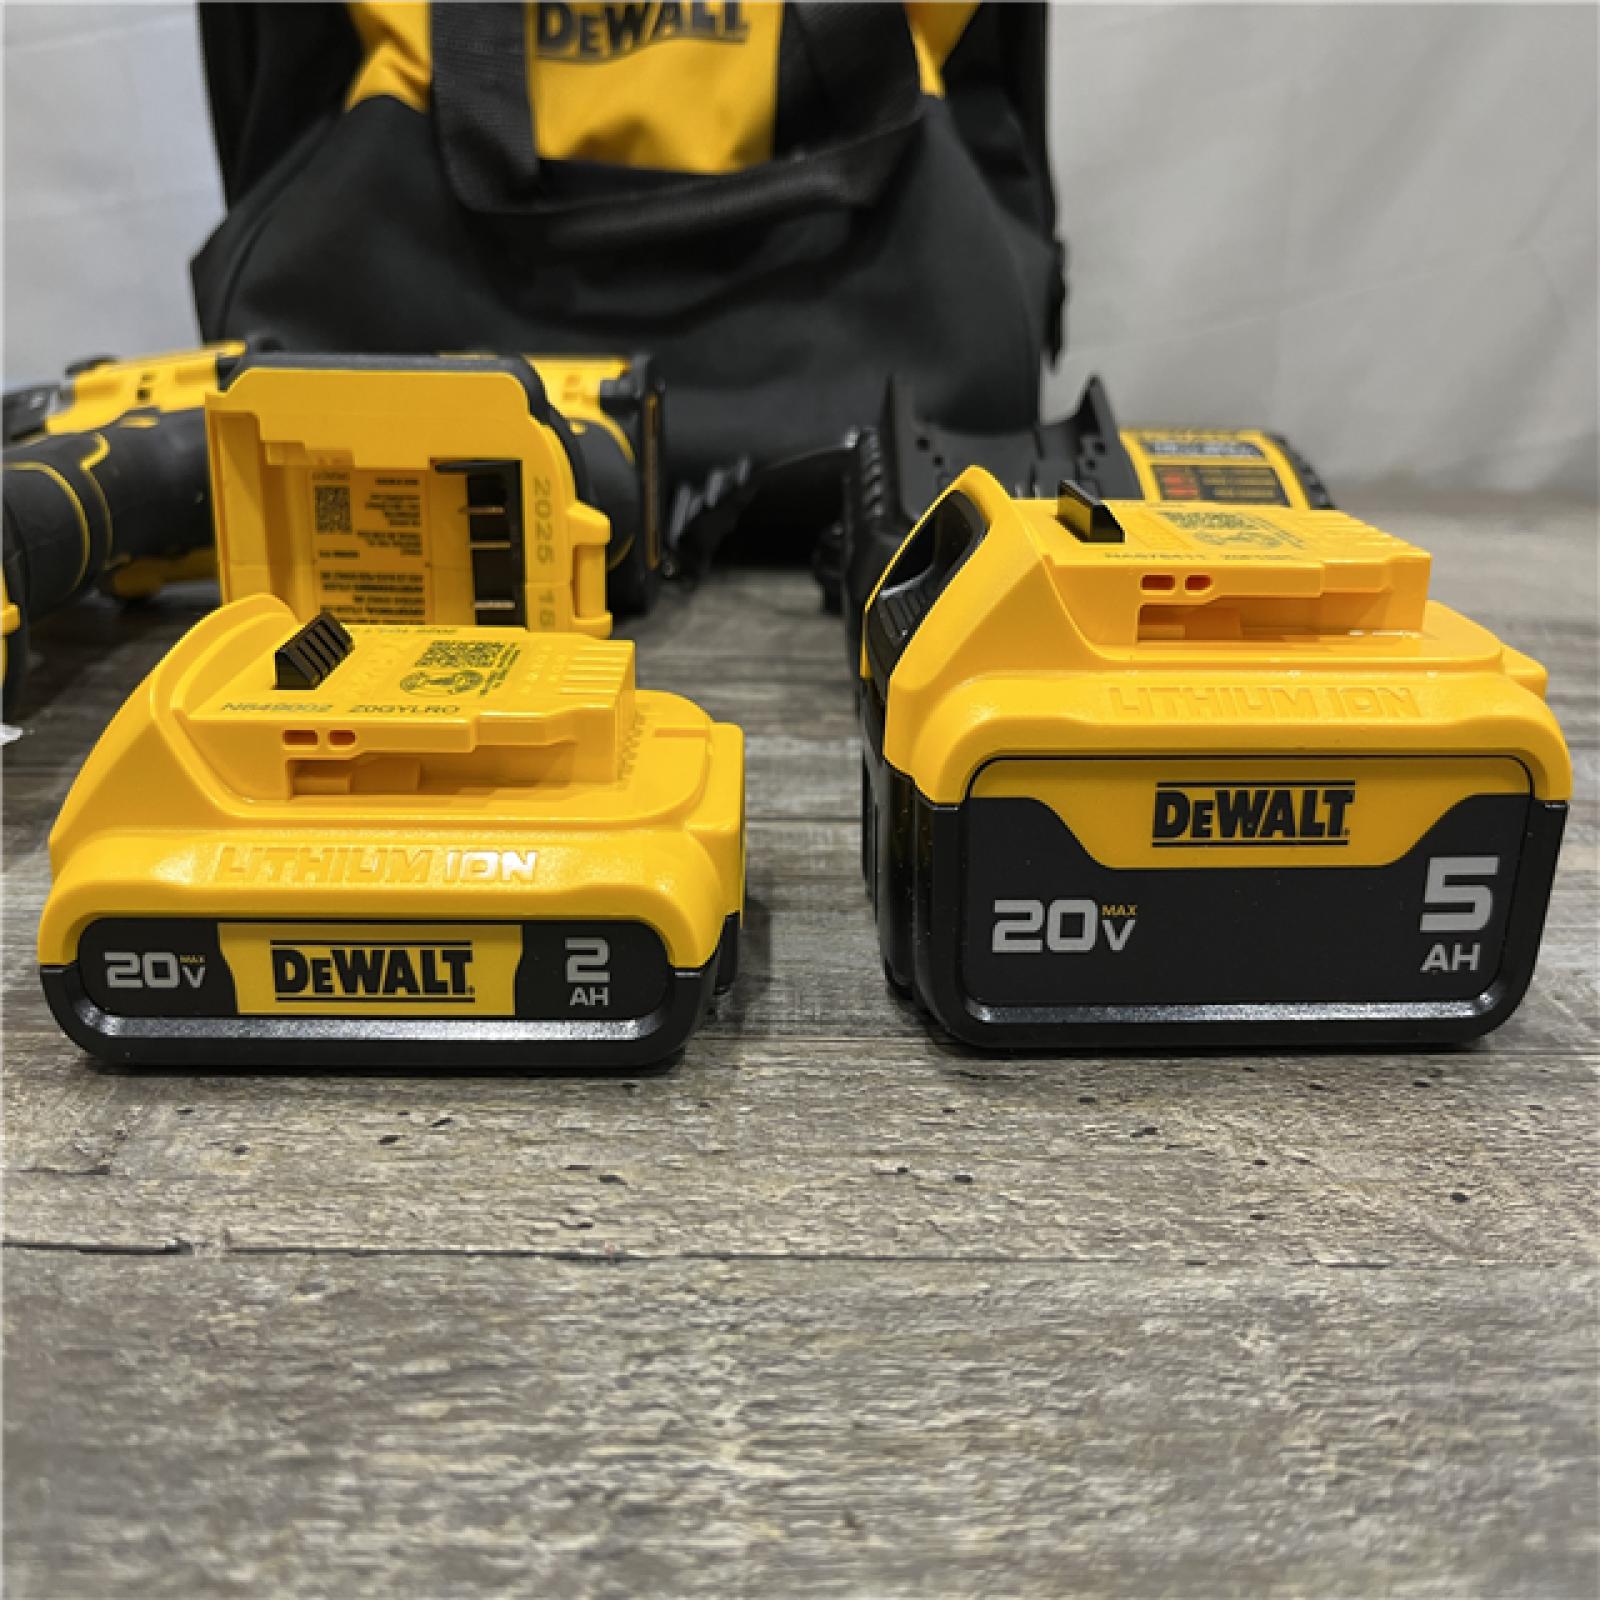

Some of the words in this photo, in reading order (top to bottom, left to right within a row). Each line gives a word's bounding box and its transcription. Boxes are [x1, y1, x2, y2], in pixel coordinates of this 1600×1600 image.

[533, 477, 553, 563] 2025
[1109, 687, 1322, 718] LITHIUM
[1327, 687, 1421, 718] ION
[1152, 789, 1356, 838] DEWALT
[215, 847, 432, 883] LITHIUM
[444, 850, 540, 883] ION
[1102, 905, 1137, 916] MAX
[1420, 856, 1499, 932] 5
[270, 949, 475, 996] DEWALT
[565, 937, 610, 983] 2
[1420, 944, 1481, 973] AH
[569, 987, 610, 1007] AH
